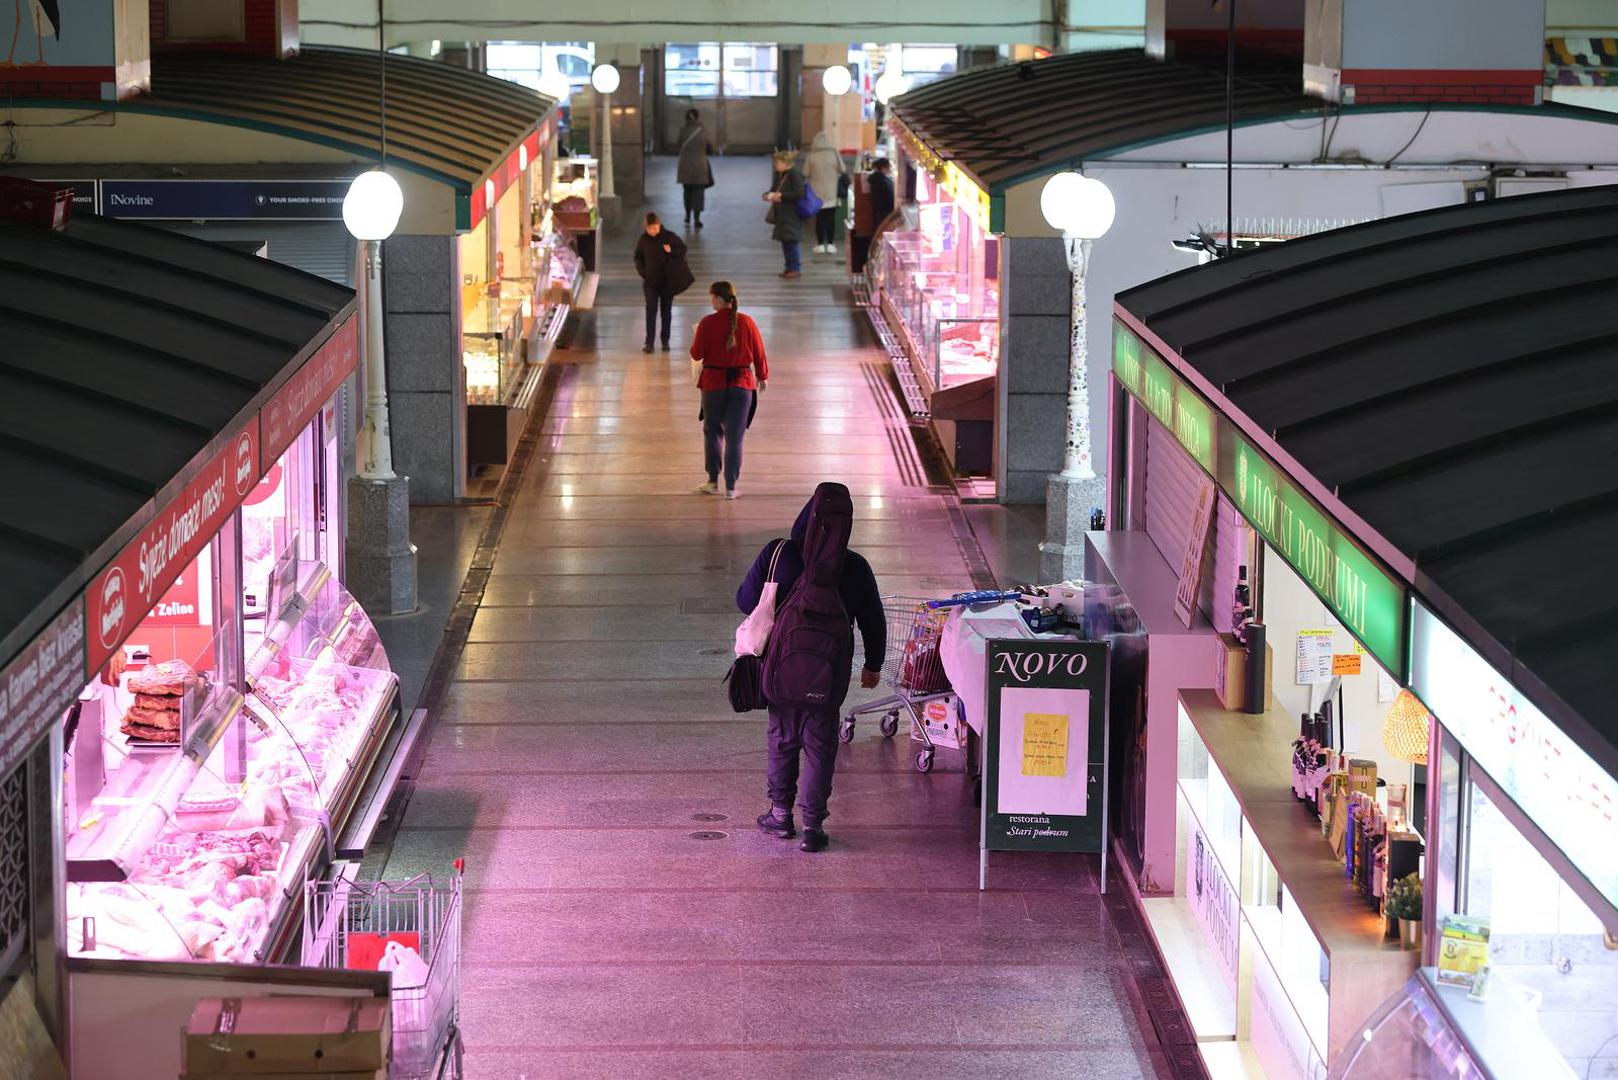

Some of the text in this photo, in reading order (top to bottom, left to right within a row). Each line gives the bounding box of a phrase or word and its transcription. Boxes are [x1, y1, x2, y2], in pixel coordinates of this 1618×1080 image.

[1297, 518, 1368, 637] PODRUMI
[994, 652, 1088, 682] NOVO
[1009, 816, 1050, 824] restorana
[1006, 826, 1032, 836] Stari
